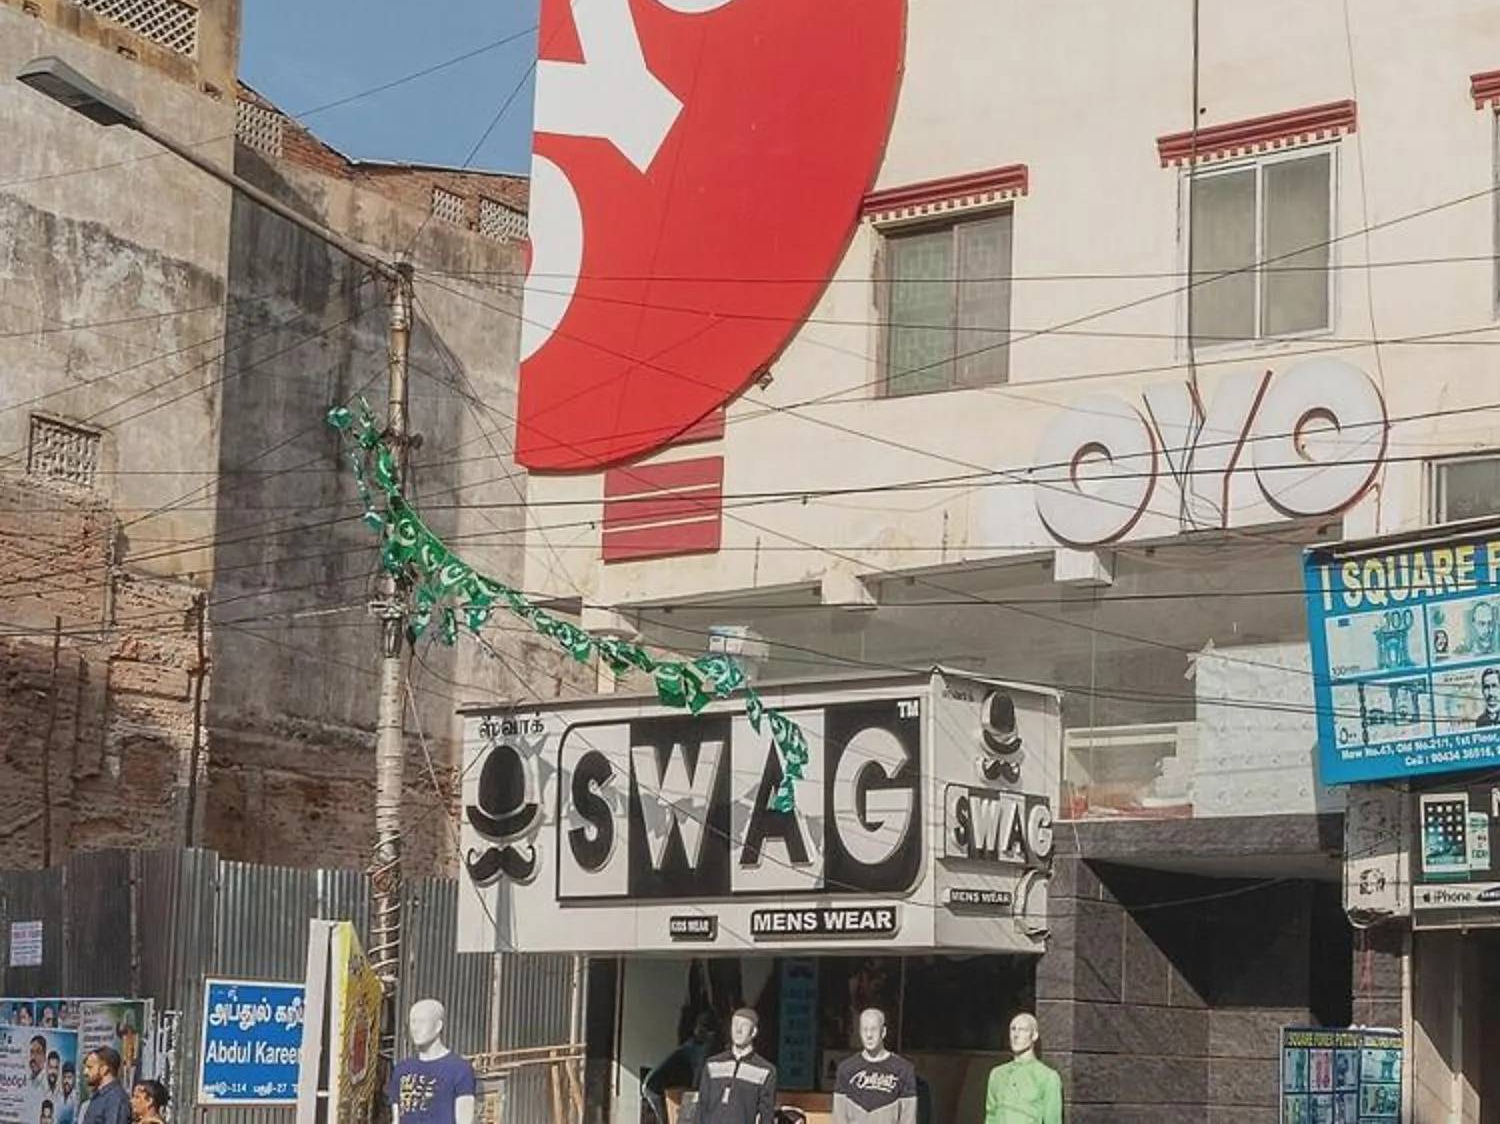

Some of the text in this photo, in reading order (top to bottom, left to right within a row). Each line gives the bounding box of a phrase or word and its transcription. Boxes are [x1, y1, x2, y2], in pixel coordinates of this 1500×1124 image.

[1034, 356, 1390, 551] OYO
[1341, 544, 1479, 608] SQUARE
[1383, 609, 1413, 629] 100
[564, 724, 914, 875] SWAG
[953, 793, 1054, 858] SWAG
[753, 910, 893, 932] MENS WEAR
[206, 1039, 302, 1065] Abdul Karee
